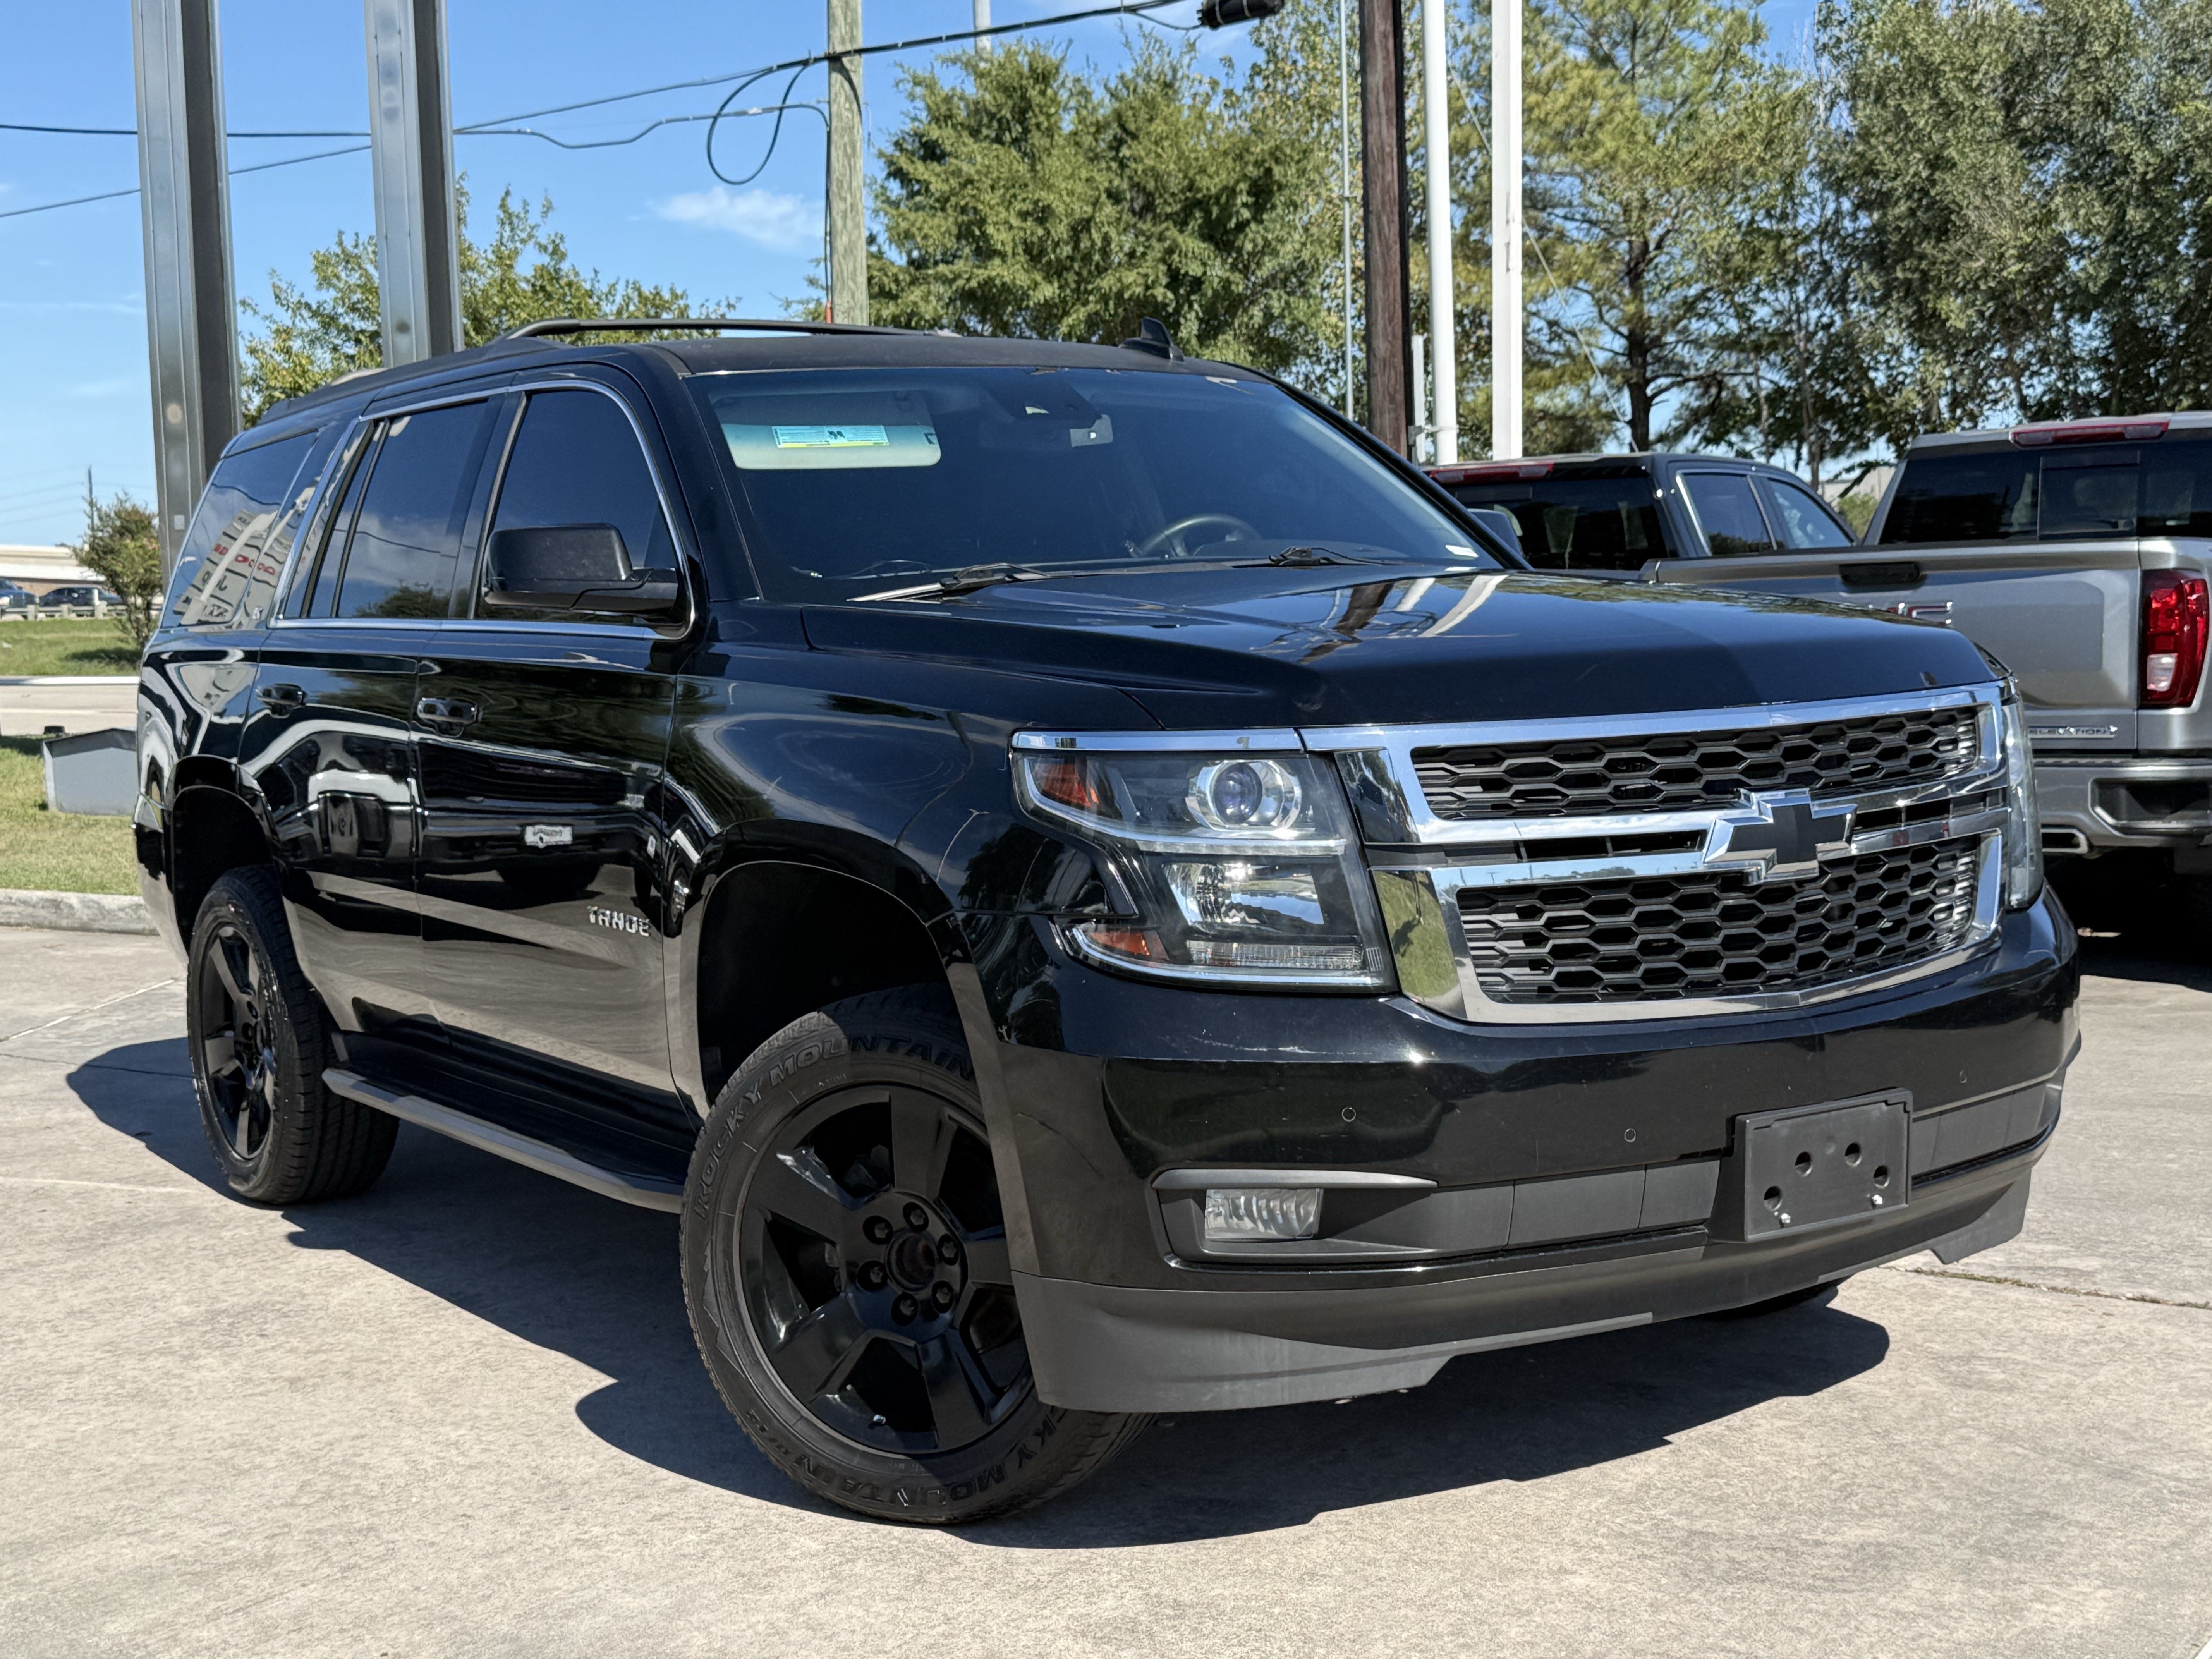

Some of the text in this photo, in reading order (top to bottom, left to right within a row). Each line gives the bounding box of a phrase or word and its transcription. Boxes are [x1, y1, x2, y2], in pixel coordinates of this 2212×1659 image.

[587, 905, 650, 937] TAHOE
[694, 1033, 975, 1219] ROCKY MOUNTAIN
